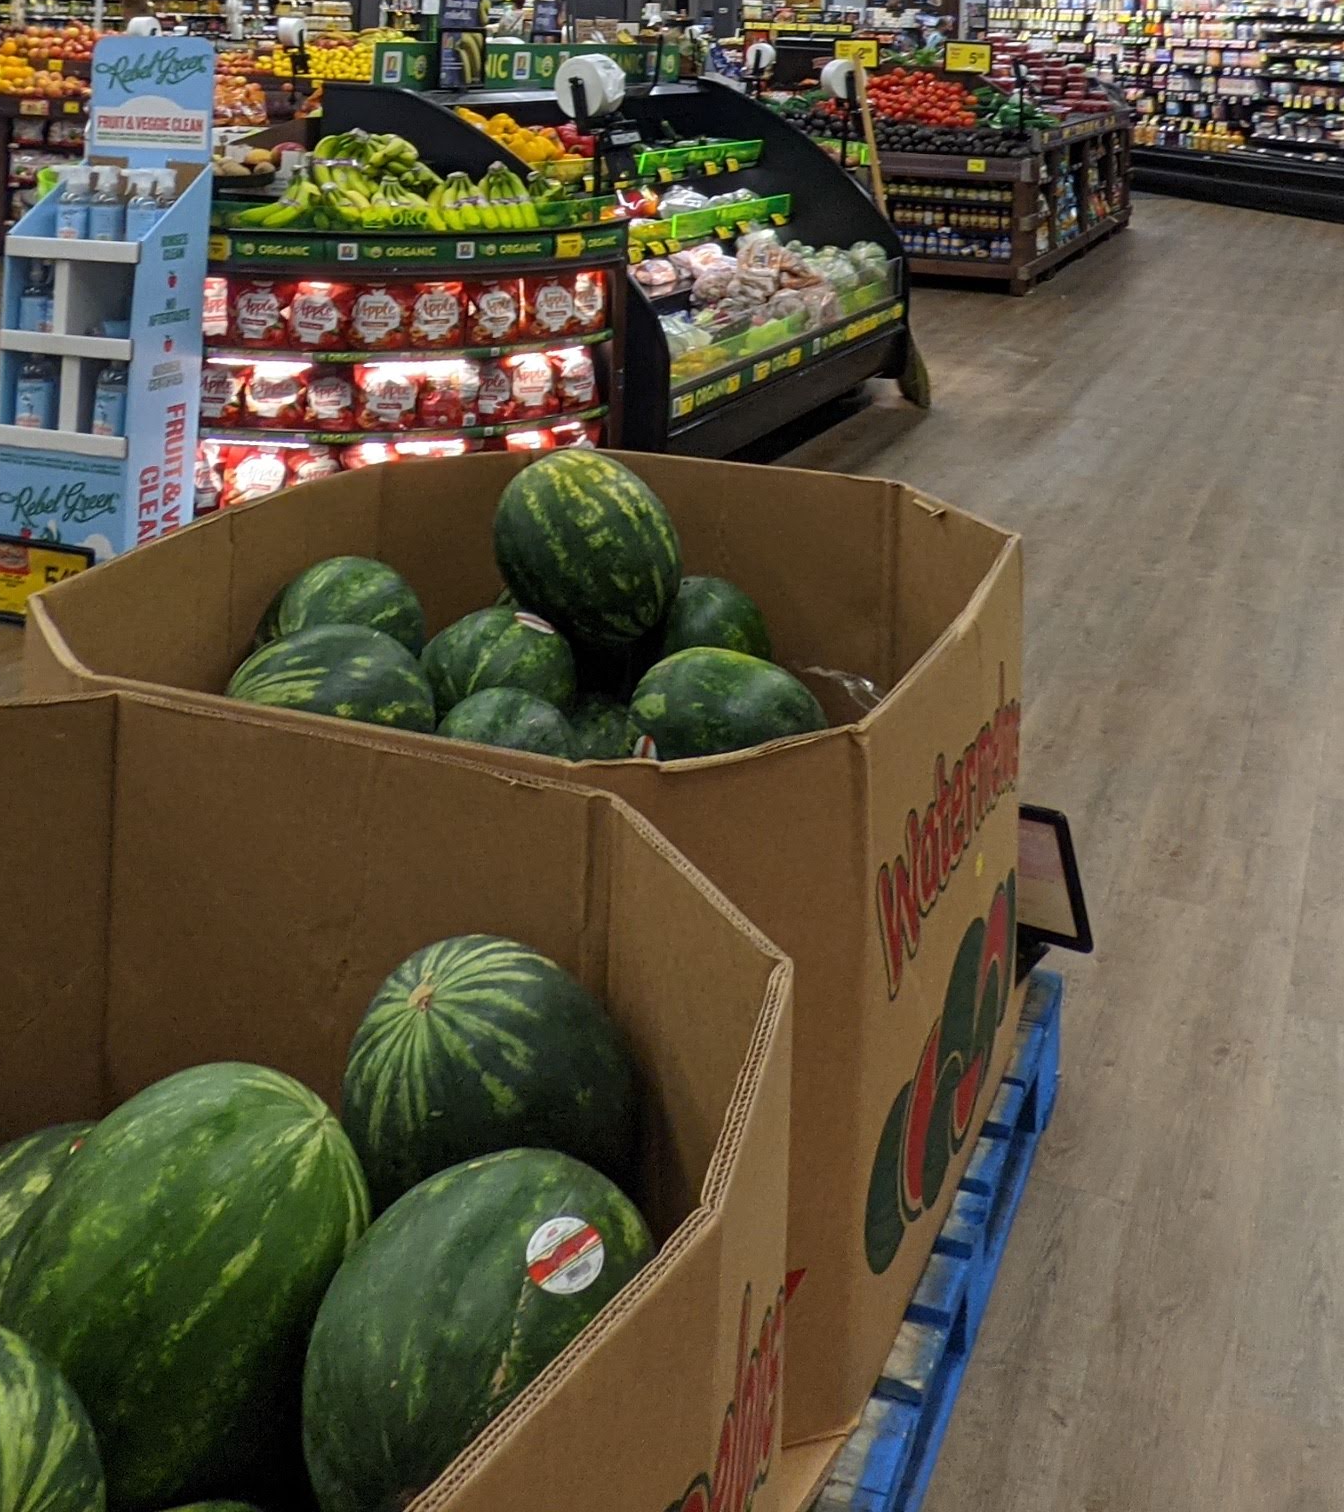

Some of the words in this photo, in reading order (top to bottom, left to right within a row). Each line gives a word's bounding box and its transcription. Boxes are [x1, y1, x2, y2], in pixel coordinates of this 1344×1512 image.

[97, 115, 124, 133] FRUIT
[137, 114, 170, 132] VEGGIE
[172, 114, 204, 133] CLEAN
[259, 244, 309, 257] ORGANIC
[385, 246, 436, 257] ORGANIC
[499, 243, 541, 254] ORGANIC
[164, 402, 187, 478] FRUIT
[62, 482, 121, 524] Green
